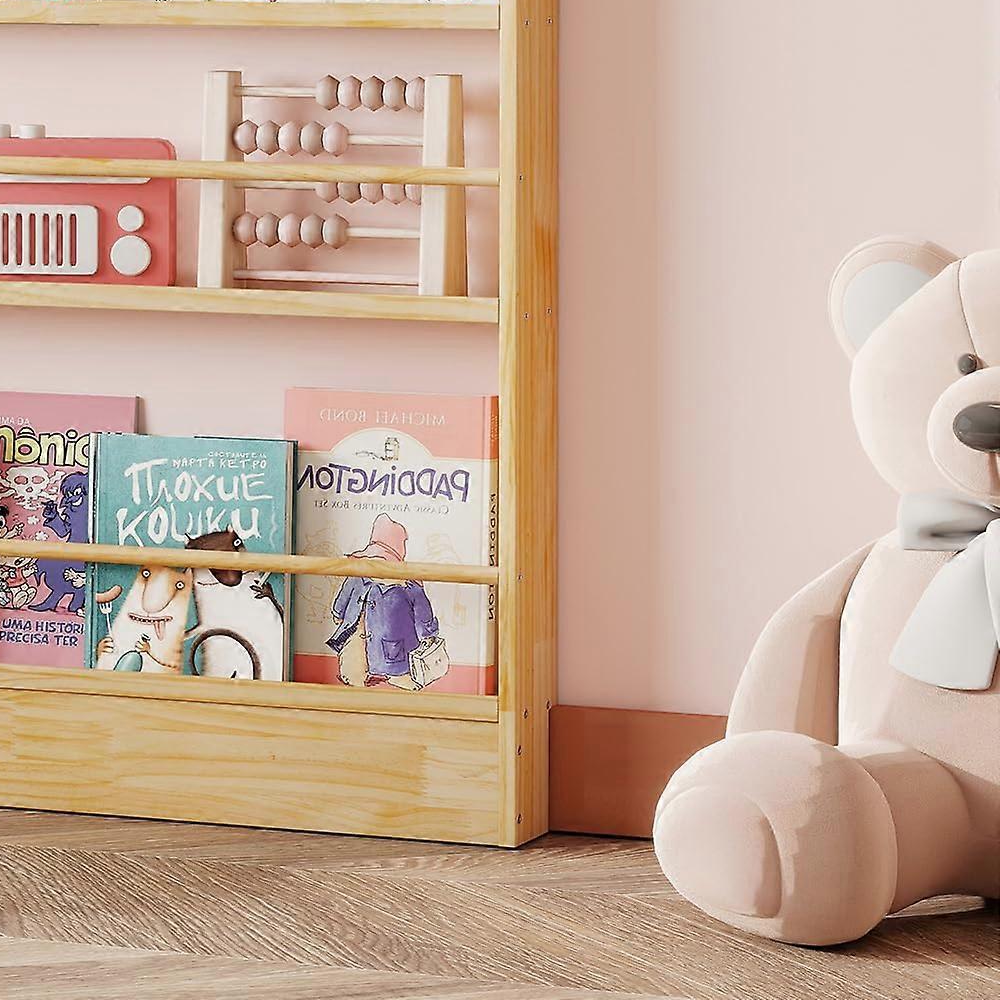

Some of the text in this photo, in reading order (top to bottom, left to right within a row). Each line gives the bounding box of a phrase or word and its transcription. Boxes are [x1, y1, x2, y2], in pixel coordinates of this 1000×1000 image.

[18, 417, 31, 426] DA
[2, 619, 84, 635] UMA HISTÓRI
[0, 631, 49, 645] PRECISA
[54, 635, 78, 647] TER
